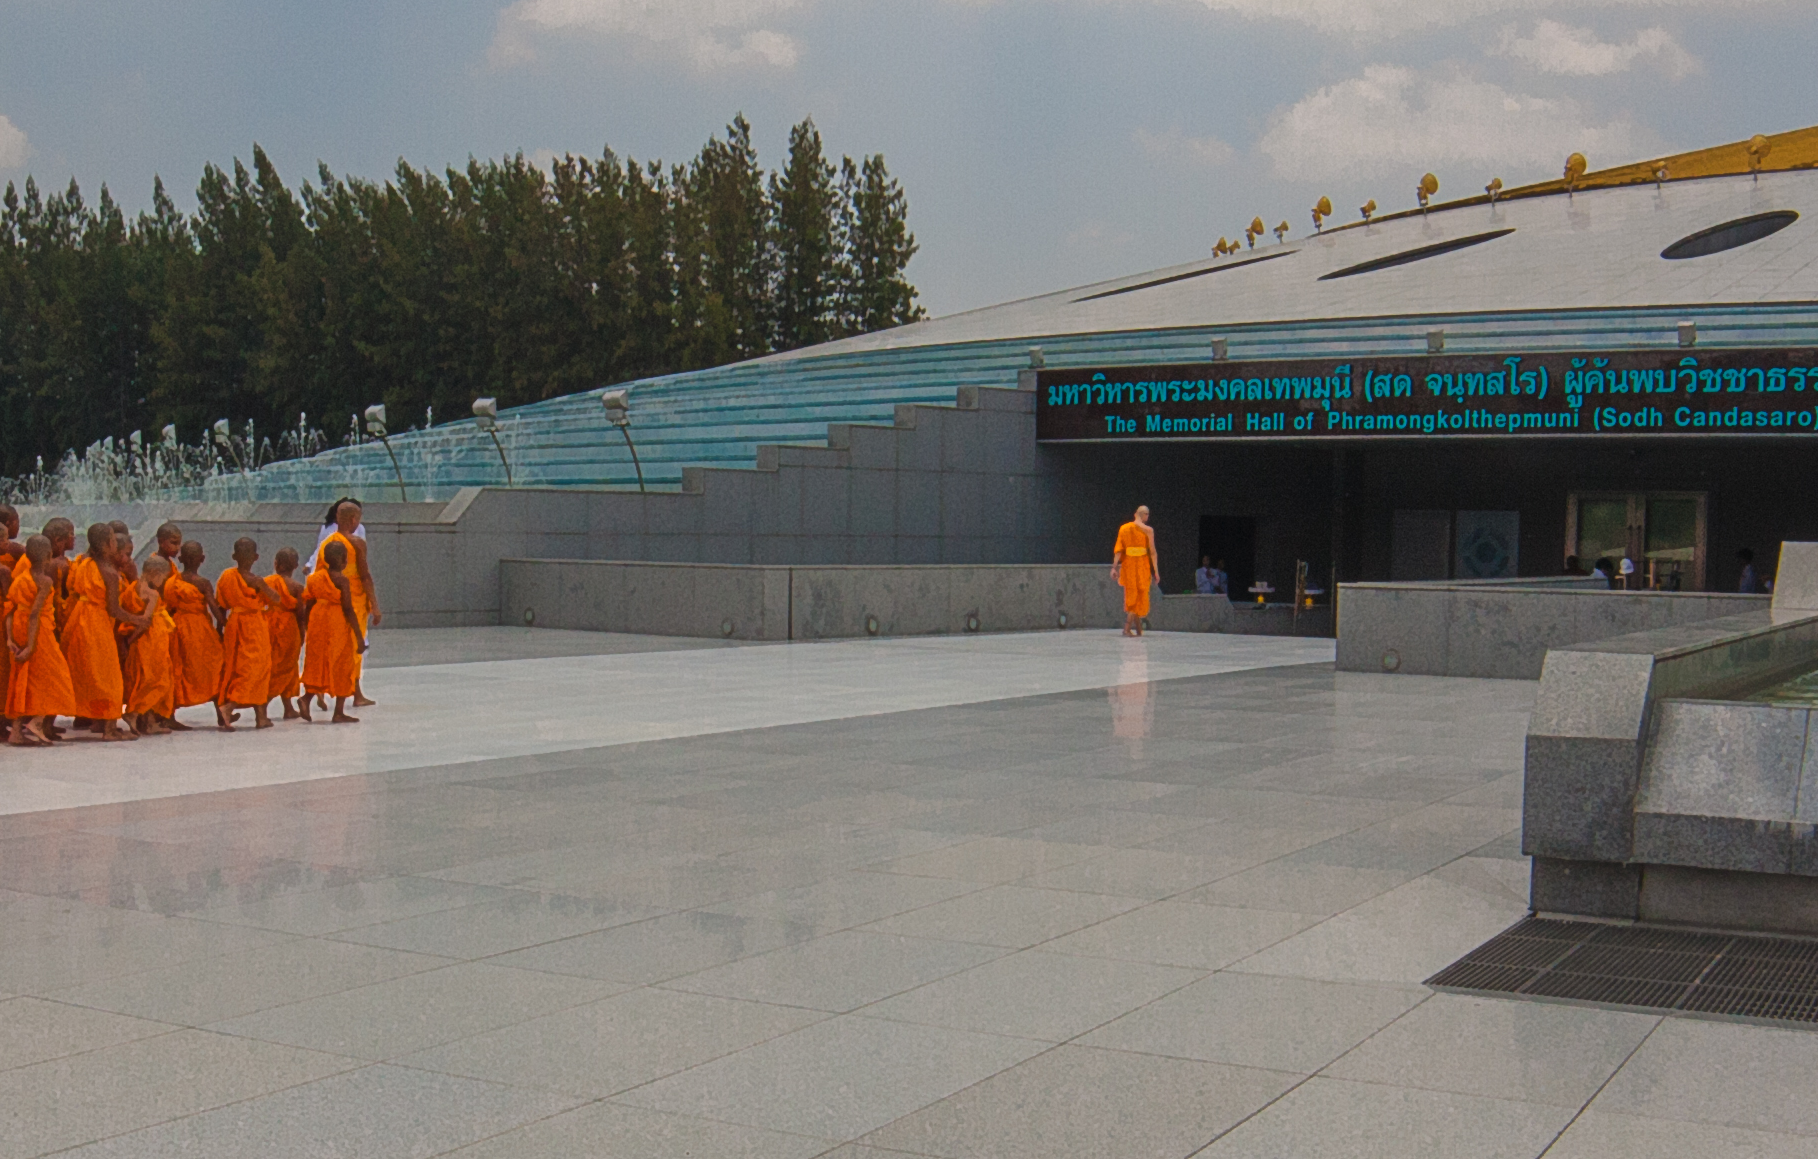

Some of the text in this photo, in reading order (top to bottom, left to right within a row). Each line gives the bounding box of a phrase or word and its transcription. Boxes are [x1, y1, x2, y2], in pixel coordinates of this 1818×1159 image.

[1047, 364, 1352, 412] มหาวิหารพระมงคลเทพมุนี
[1364, 369, 1412, 403] (สด
[1104, 415, 1137, 434] The
[1145, 413, 1233, 434] Memorial
[1246, 412, 1285, 431] Hall
[1293, 411, 1314, 431] of
[1327, 407, 1579, 434] Phramongkolthepmuni
[1593, 405, 1663, 431] (Sodh
